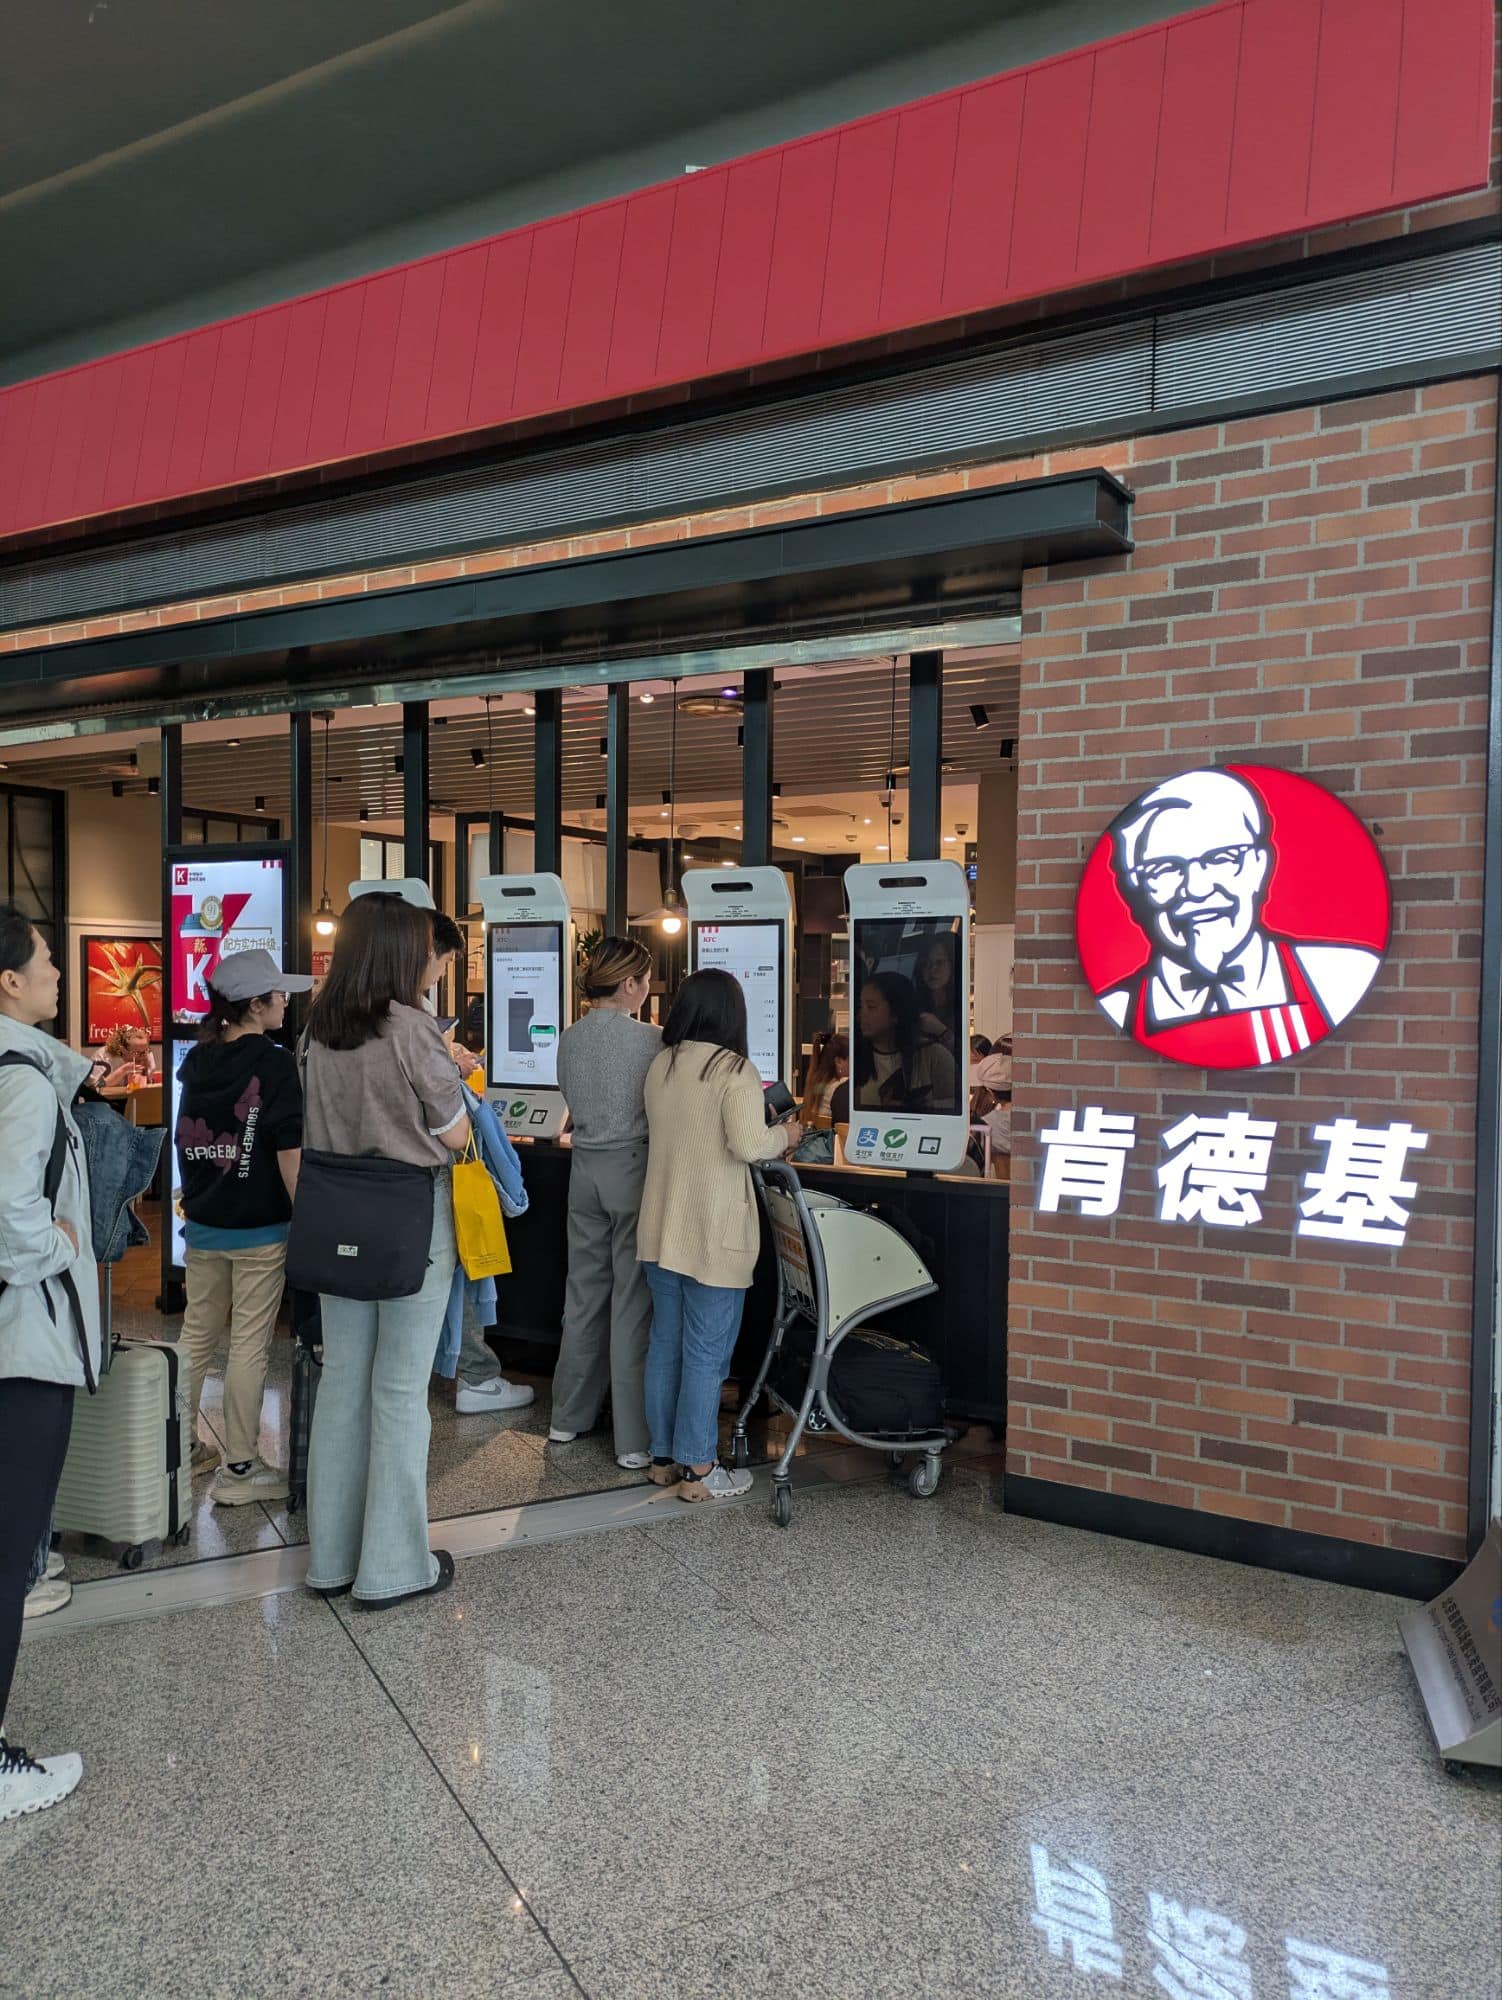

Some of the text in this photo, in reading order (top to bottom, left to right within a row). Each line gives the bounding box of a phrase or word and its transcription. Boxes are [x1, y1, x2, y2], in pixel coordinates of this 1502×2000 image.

[89, 1022, 152, 1039] fress
[238, 1106, 260, 1178] SQUAREPANTS
[1038, 1106, 1428, 1247] 肯德基
